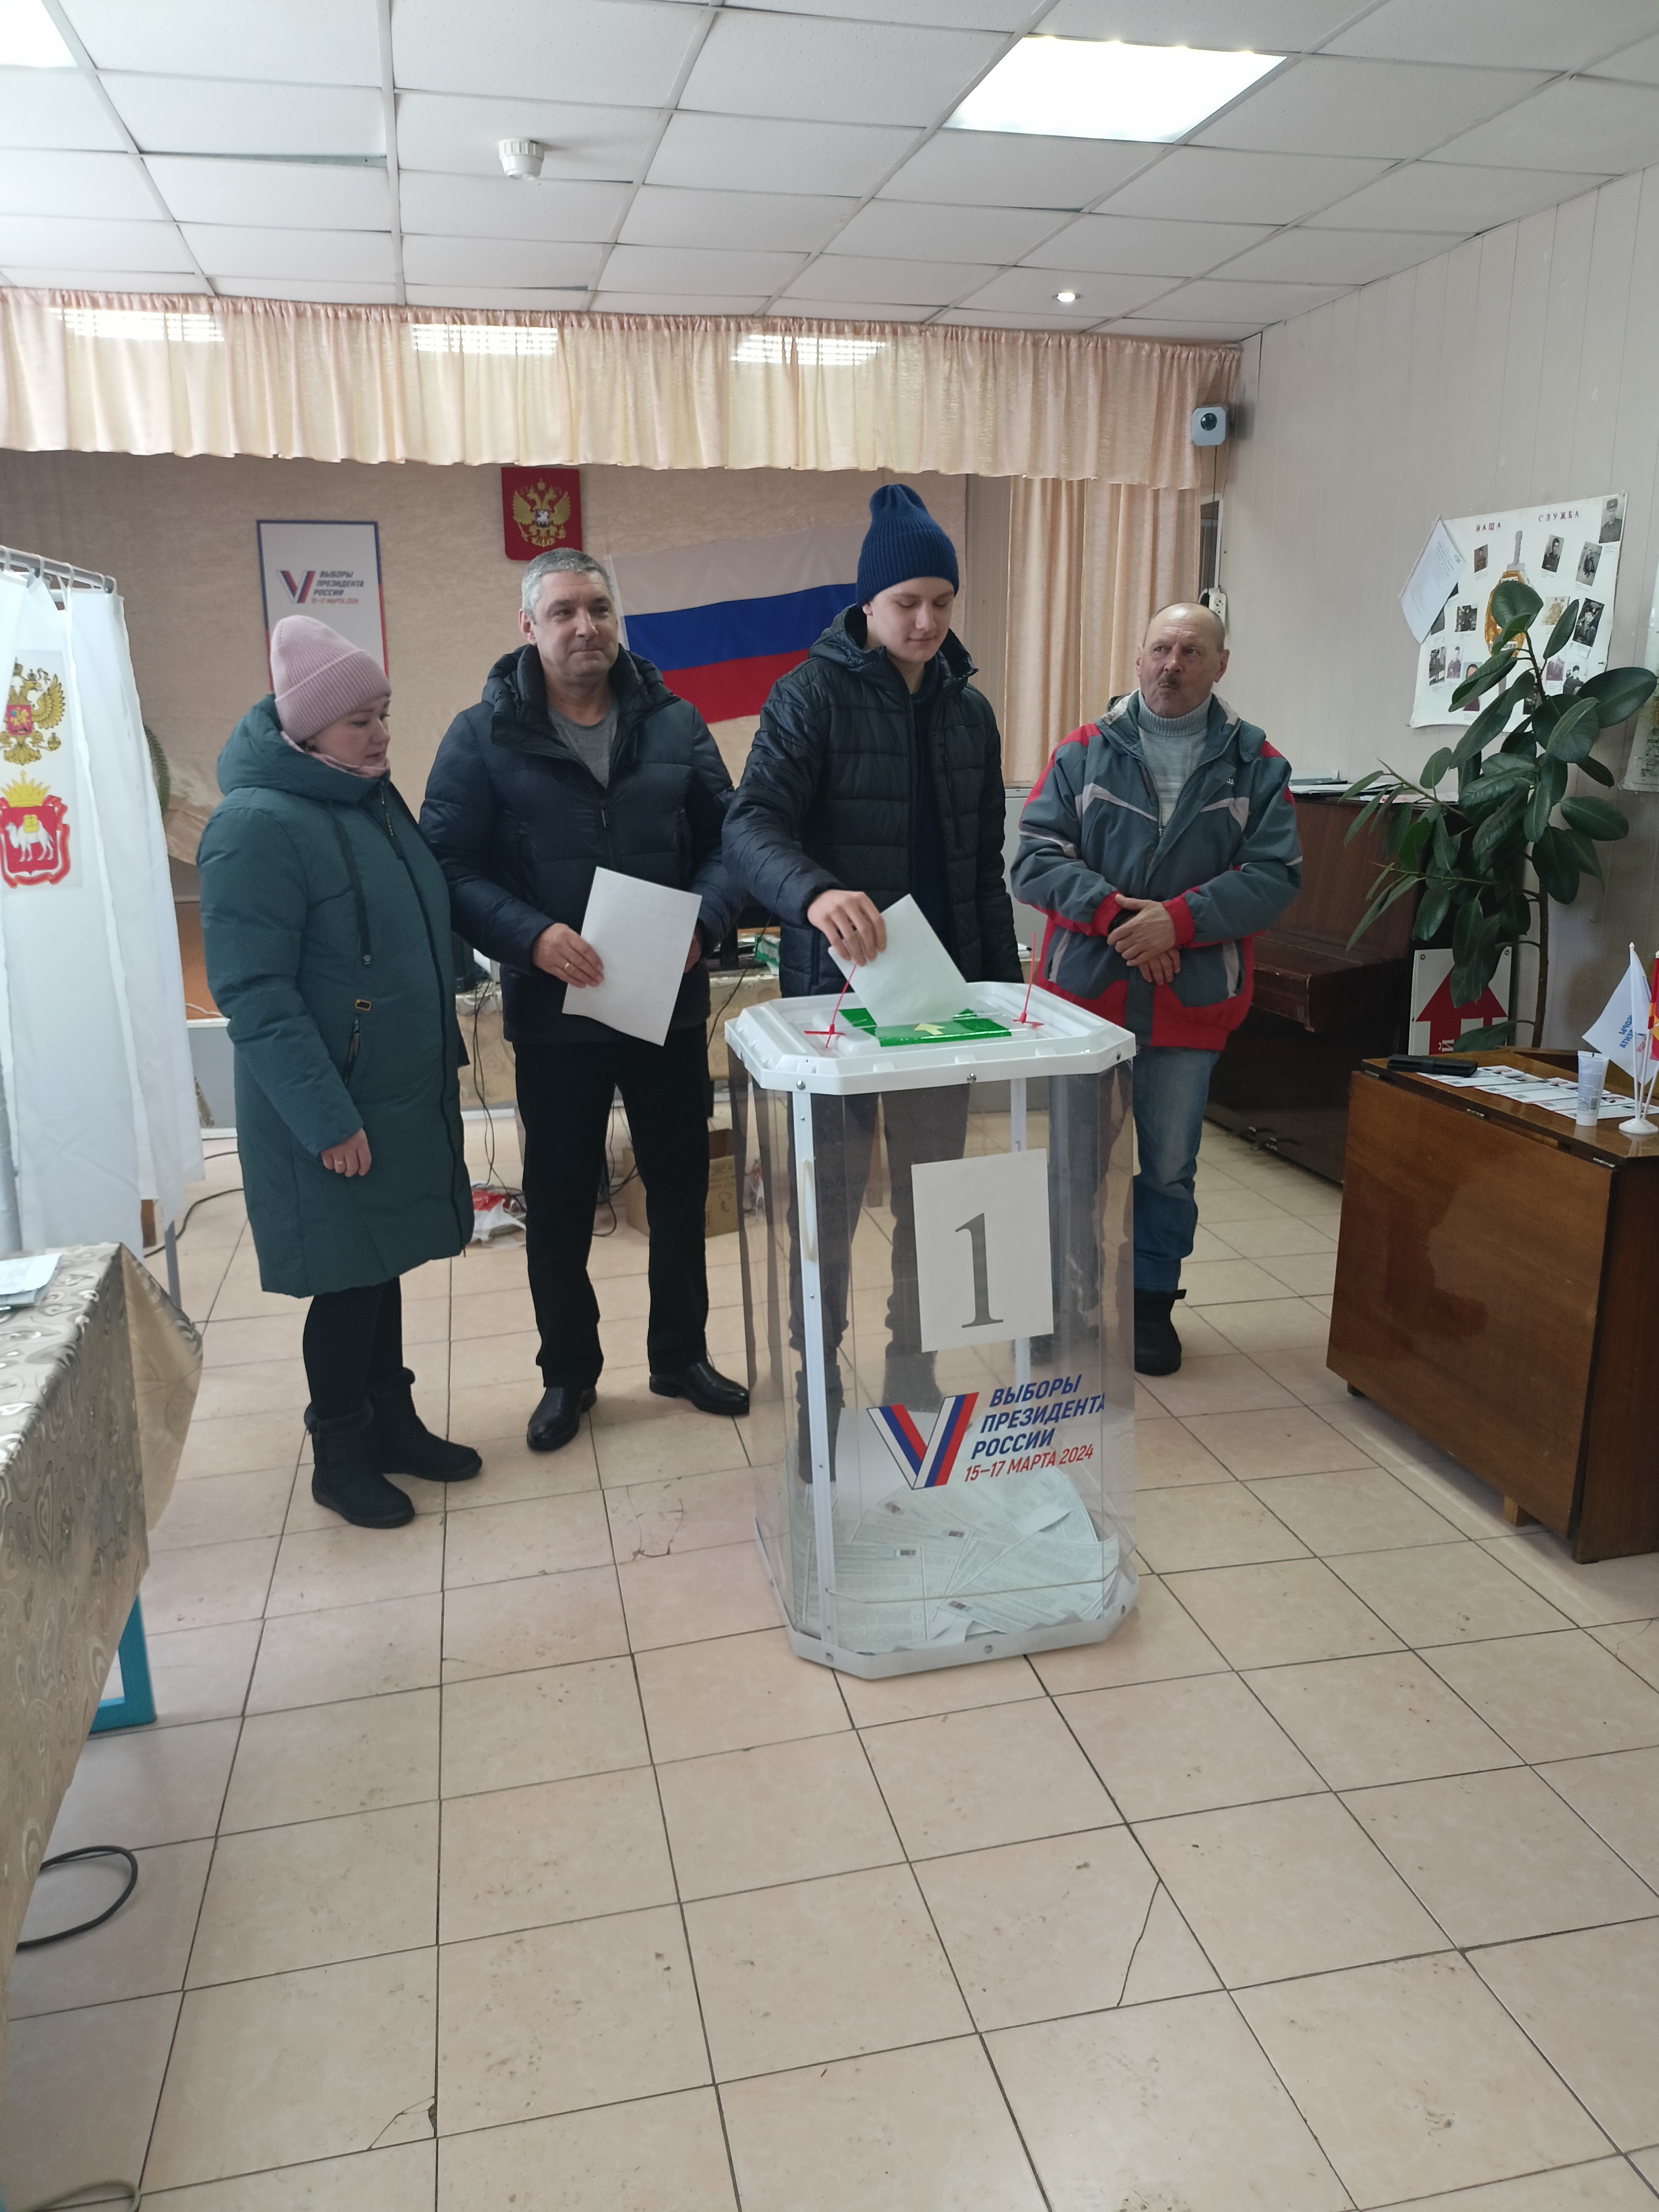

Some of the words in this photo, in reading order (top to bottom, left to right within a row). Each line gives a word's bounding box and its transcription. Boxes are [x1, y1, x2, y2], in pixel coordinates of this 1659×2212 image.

[1476, 522, 1501, 532] НАША
[1538, 510, 1579, 522] СЛУЖБА
[316, 579, 364, 587] ПРЕЗИДЕНТА
[955, 1213, 1004, 1328] 1
[989, 1374, 1082, 1408] ВЫБОРЫ
[980, 1393, 1105, 1434] ПРЕЗИДЕНТА
[971, 1428, 1056, 1460] РОССИИ
[1007, 1451, 1057, 1475] МАРТА
[1059, 1444, 1094, 1466] 2024
